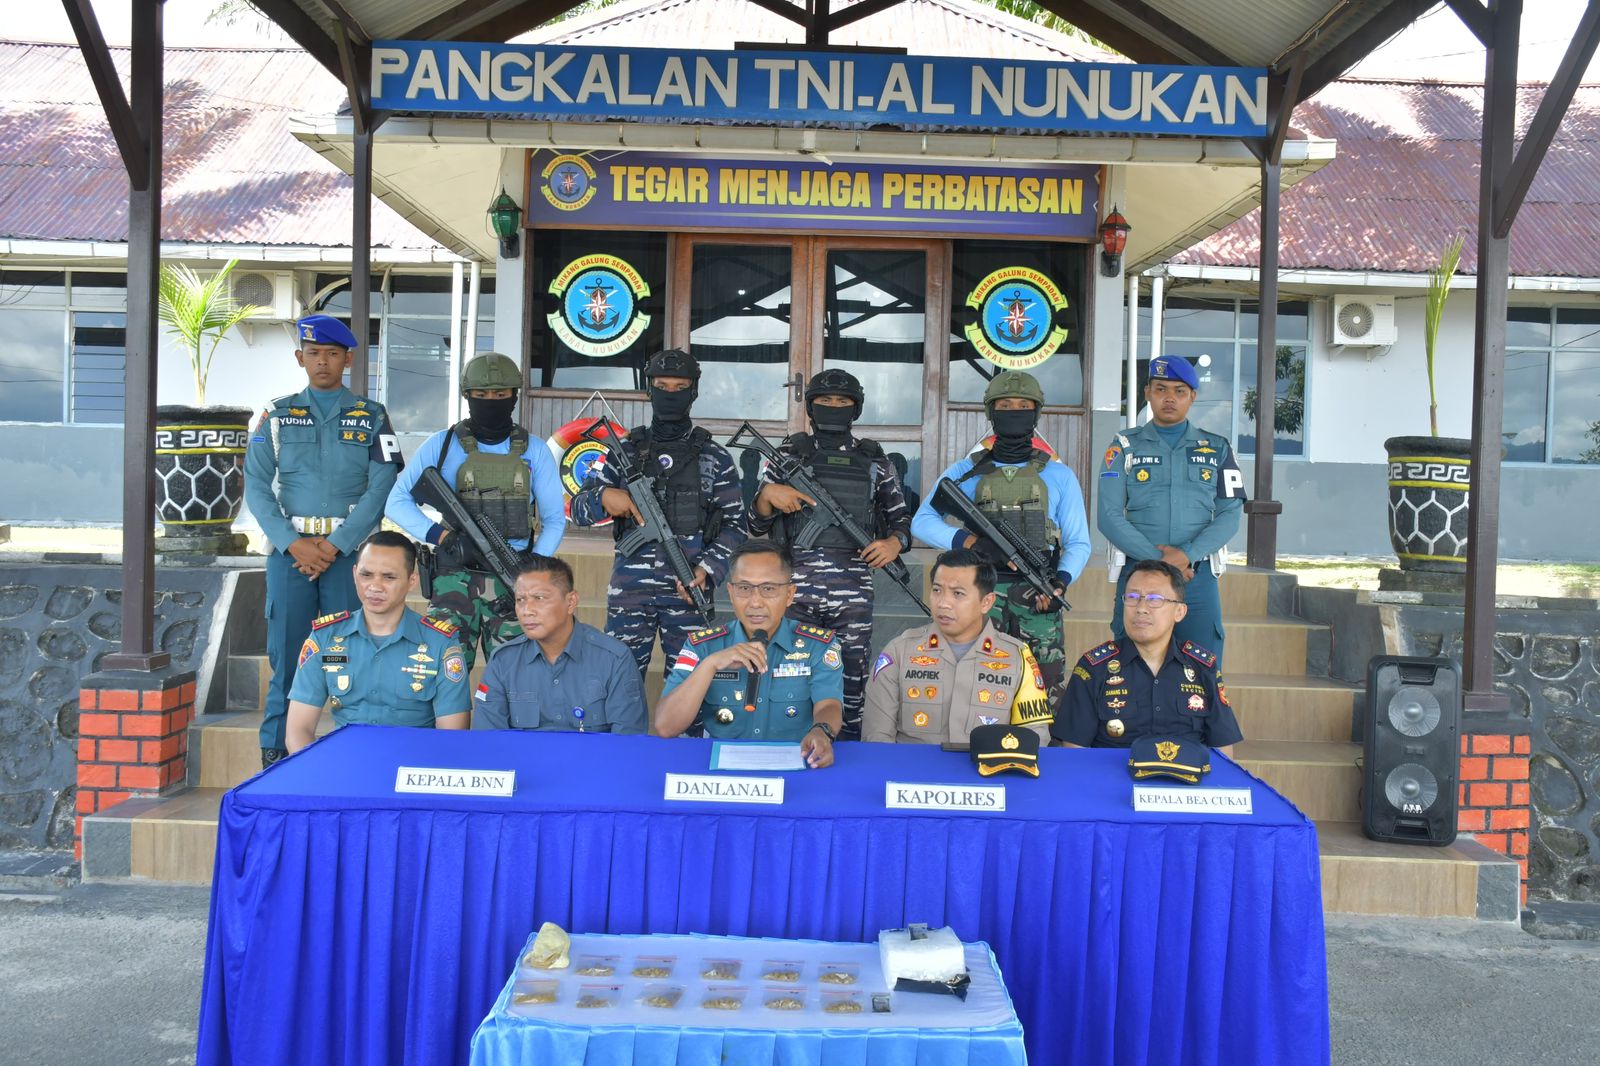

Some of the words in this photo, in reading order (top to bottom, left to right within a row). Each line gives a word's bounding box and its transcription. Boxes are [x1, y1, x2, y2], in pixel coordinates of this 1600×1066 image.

[373, 47, 738, 108] PANGKALAN
[970, 65, 1267, 126] NUNUKAN
[609, 165, 710, 205] TEGAR
[720, 168, 872, 209] MENJAGA
[882, 172, 1083, 215] PERBATASAN
[558, 264, 580, 288] MIKANG
[580, 257, 610, 267] GALUNG
[612, 260, 642, 290] SEMPADAN
[975, 277, 997, 300] MIKANG
[998, 270, 1026, 279] GALUNG
[1028, 272, 1060, 303] SEMPADAN
[558, 327, 586, 353] LANAL
[592, 328, 638, 354] NUNUKAN
[976, 340, 1003, 364] LANAL
[1010, 344, 1056, 367] NUNUKAN
[280, 417, 314, 426] YUDHA
[360, 420, 372, 429] AL
[379, 434, 401, 462] P
[1209, 458, 1218, 466] AL
[1223, 469, 1243, 498] P
[904, 670, 940, 680] AROFIEK
[978, 673, 1012, 686] POLRI
[406, 772, 468, 788] KEPALA
[470, 776, 505, 790] BNN
[675, 780, 773, 798] DANLANAL
[896, 790, 996, 808] KAPOLRES
[1138, 793, 1182, 805] KEPALA
[1186, 794, 1208, 806] BEA
[1209, 795, 1248, 807] CUKAI
